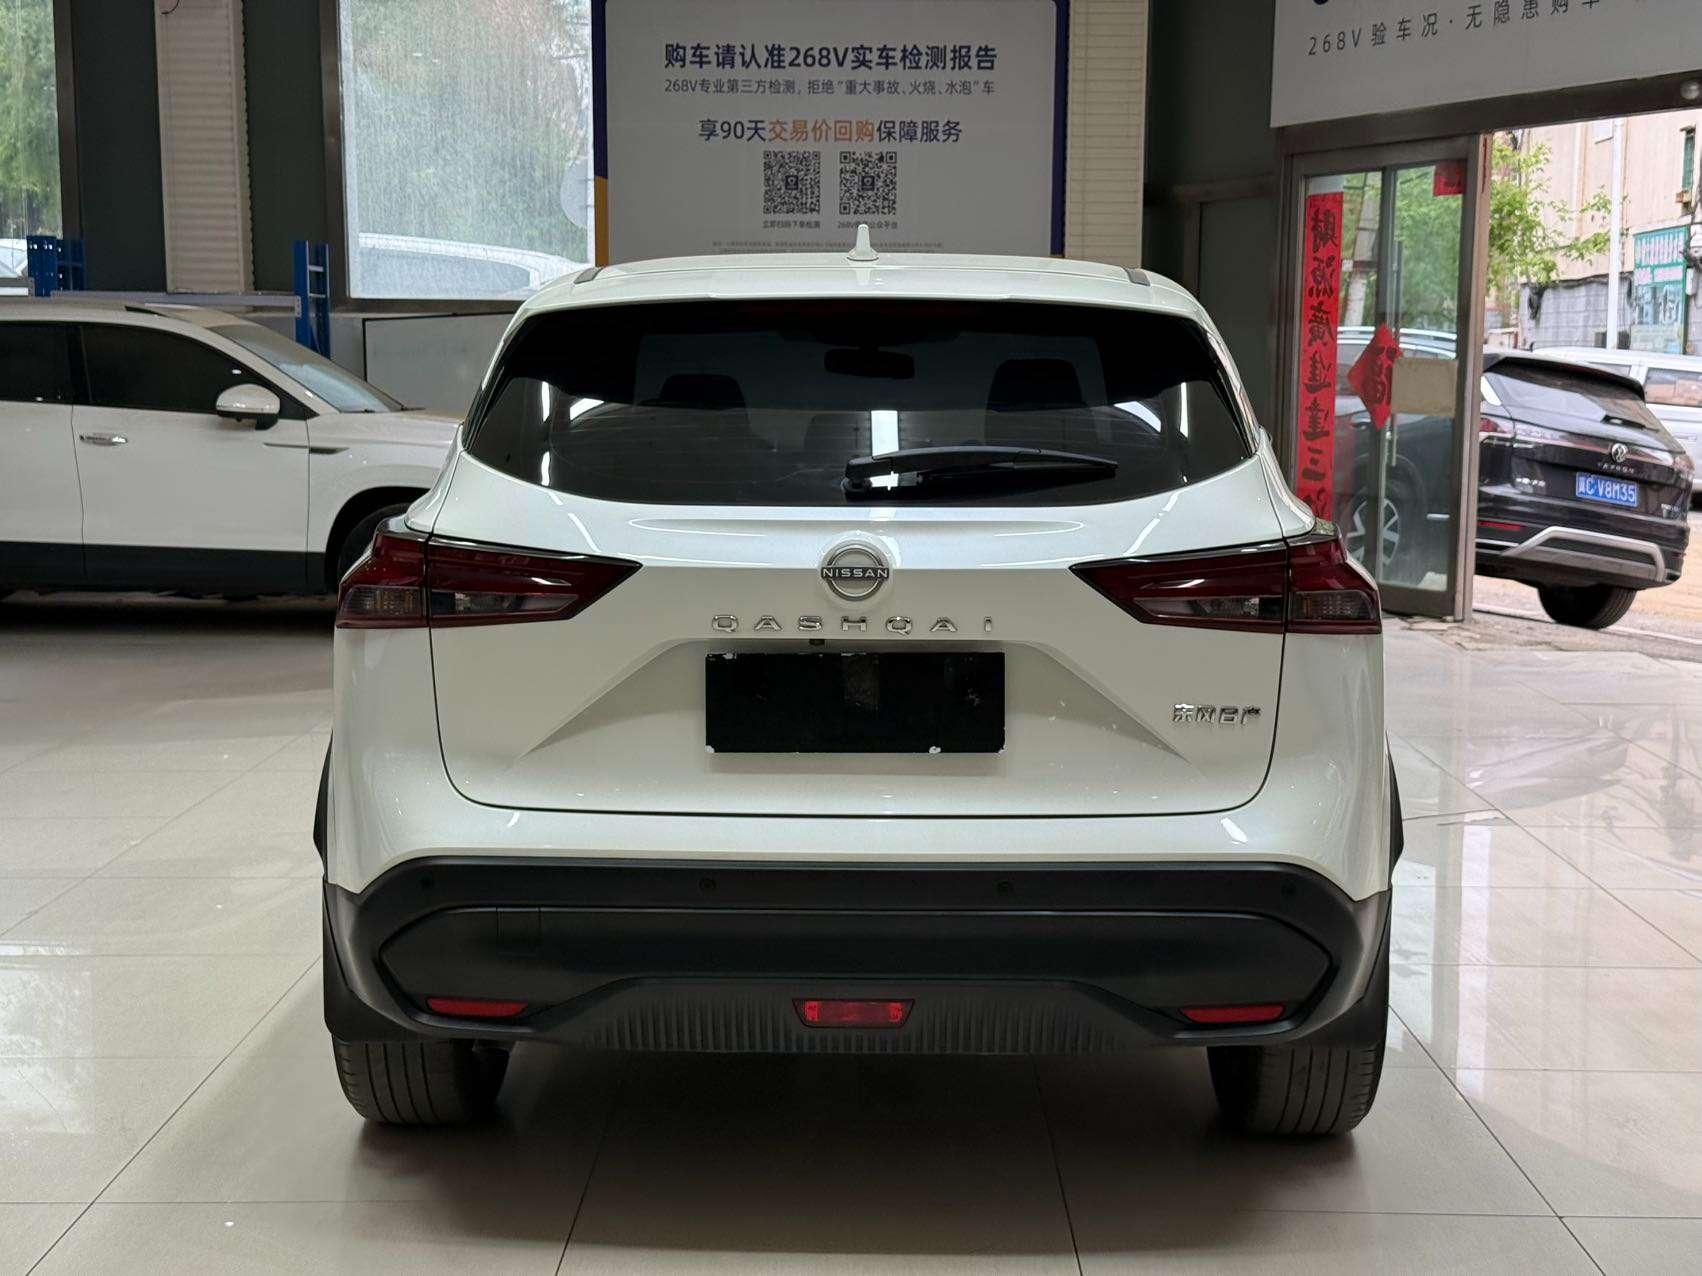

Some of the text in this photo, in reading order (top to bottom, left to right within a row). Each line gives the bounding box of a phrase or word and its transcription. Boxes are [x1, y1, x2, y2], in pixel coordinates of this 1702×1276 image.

[664, 43, 997, 71] 购车请认准268V实车检测报告
[699, 118, 962, 143] 享90天交易价回购保障服务
[823, 568, 888, 578] NISSAN
[711, 614, 993, 635] QASHQAI
[1173, 703, 1261, 725] 东风日产
